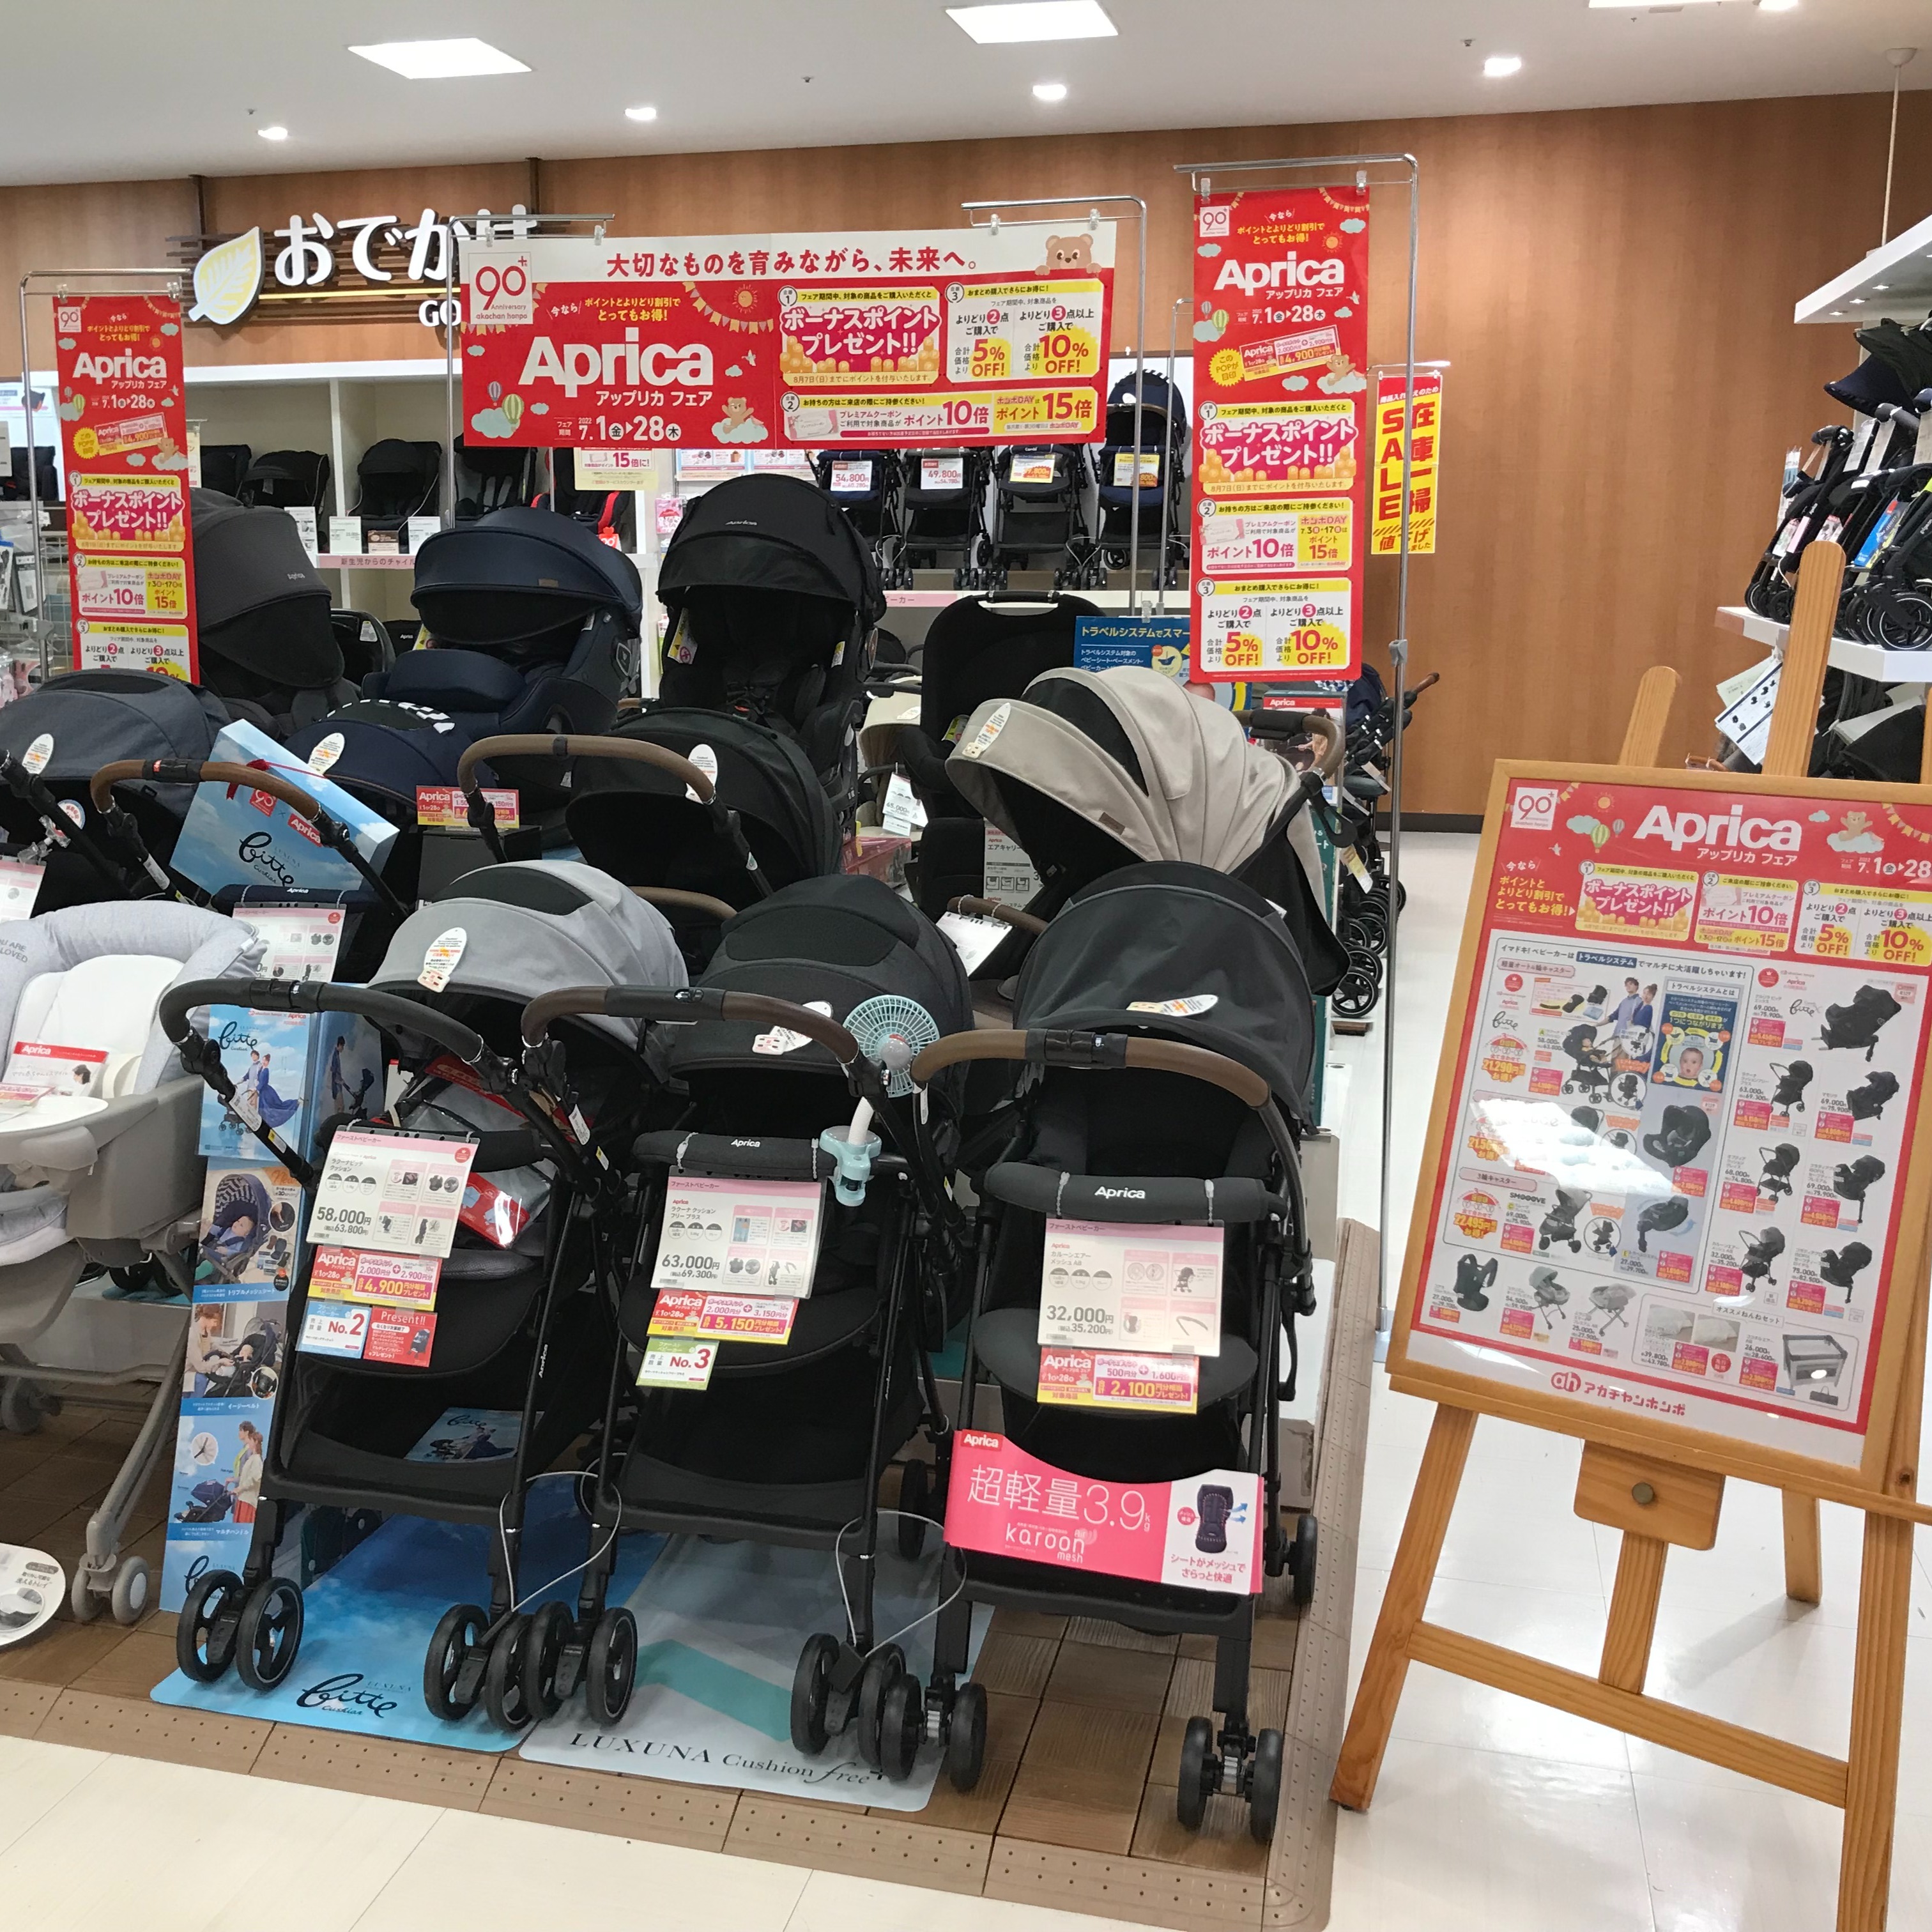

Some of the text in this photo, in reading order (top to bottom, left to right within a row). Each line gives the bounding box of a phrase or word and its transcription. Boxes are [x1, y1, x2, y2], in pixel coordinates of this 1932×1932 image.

[1269, 210, 1292, 221] 今なら
[1237, 222, 1324, 234] ポイントとよりどり割引で
[607, 246, 976, 277] 大切なものを育みながら、未来へ。
[1213, 251, 1344, 296] Aprica
[551, 303, 578, 316] 今なら
[585, 297, 680, 309] ポイントとよりどり割引で
[597, 309, 668, 321] とってもお得!
[783, 307, 938, 330] ボーナスポイント
[965, 325, 998, 335] ご購入で
[1038, 321, 1073, 332] ご購入で
[802, 334, 917, 356] プレゼント!!
[973, 338, 1005, 362] 5%
[1039, 334, 1089, 359] 10%
[1243, 345, 1273, 358] Aprica
[72, 348, 167, 384] Aprica
[518, 327, 714, 397] Aprica
[1046, 360, 1080, 374] OFF!
[1216, 362, 1239, 373] POPが
[972, 363, 1004, 378] OFF!
[1380, 387, 1438, 404] 商品入れえのため
[839, 410, 901, 418] プレミアムクーポン
[839, 419, 901, 428] ご利用で対象商品が
[1204, 419, 1355, 445] ボーナスポイント
[1221, 443, 1333, 467] プレゼント!!
[1379, 407, 1404, 521] SALE
[73, 493, 181, 509] ボーナスポイント
[1379, 528, 1430, 551] 値げ
[1309, 544, 1338, 559] 15倍
[1225, 632, 1258, 652] 5%
[1290, 630, 1338, 650] 10%
[1225, 654, 1259, 666] OFF!
[1297, 652, 1331, 664] OFF!
[419, 792, 450, 802] Aprica
[291, 819, 321, 843] Aprica
[1633, 804, 1802, 851] Aprica
[1506, 861, 1536, 871] 今なら
[1500, 876, 1545, 888] ポイントと
[1498, 887, 1565, 900] よりどり割引で
[1586, 880, 1692, 903] ボーナスポイント
[1597, 897, 1674, 916] プレゼント!!
[1814, 914, 1845, 923] ご購入で
[1882, 919, 1912, 929] ご購入で
[1818, 924, 1849, 943] 5%
[1881, 930, 1924, 951] 10%
[9, 941, 26, 951] ARE
[1816, 942, 1847, 955] OFF!
[1579, 953, 1634, 967] トラベルシステム
[1883, 950, 1916, 962] OFF!
[1671, 982, 1735, 995] トラベルシステムとは
[22, 1045, 51, 1054] Aprica
[337, 1134, 381, 1143] ファーストベビーカー
[731, 1139, 760, 1147] Aprica
[1095, 1186, 1146, 1199] Aprica
[317, 1207, 371, 1226] 58,000円
[1049, 1223, 1105, 1232] ファーストベビーカー
[318, 1253, 356, 1266] Aprica
[662, 1255, 719, 1270] 63,000円
[360, 1266, 391, 1276] 2,000円分
[401, 1270, 433, 1281] 2,900円分
[659, 1294, 702, 1307] Aprica
[707, 1307, 740, 1315] 2,000円分
[754, 1309, 788, 1318] 3,150円分
[1046, 1306, 1114, 1324] 32,000円
[1717, 1305, 1781, 1325] オススメねんねセット
[381, 1311, 425, 1326] Present!!
[1044, 1355, 1091, 1368] Aprica
[1584, 1381, 1686, 1417] アカチャンホンポ
[964, 1434, 999, 1448] Aprica
[1006, 1522, 1084, 1554] karoon
[1057, 1552, 1083, 1563] mesh
[1171, 1554, 1246, 1572] シートがメッシュで
[1182, 1568, 1232, 1584] さらっと快適
[570, 1733, 813, 1779] LUXUNA Cushion
